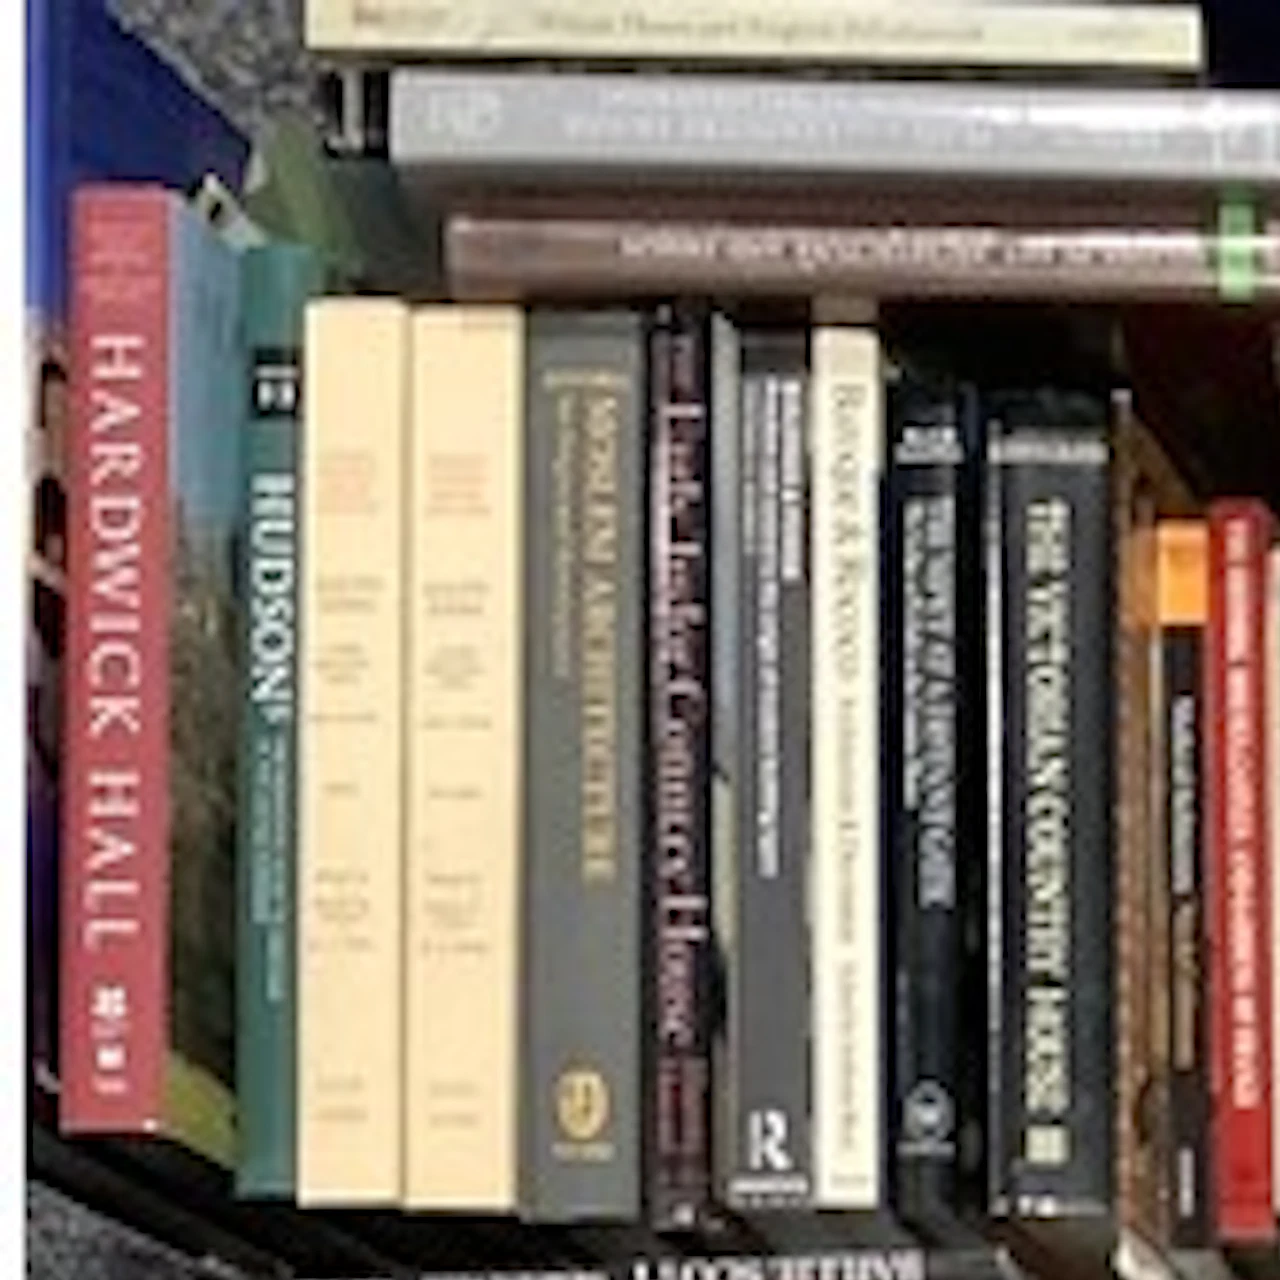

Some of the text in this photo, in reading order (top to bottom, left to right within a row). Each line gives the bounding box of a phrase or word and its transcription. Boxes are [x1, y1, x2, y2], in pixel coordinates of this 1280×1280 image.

[84, 332, 144, 949] HARDWICK HALL
[579, 577, 618, 884] ARCHITECTURE
[1026, 499, 1070, 1111] THE VICTORIAN COUNTRY HOUSE
